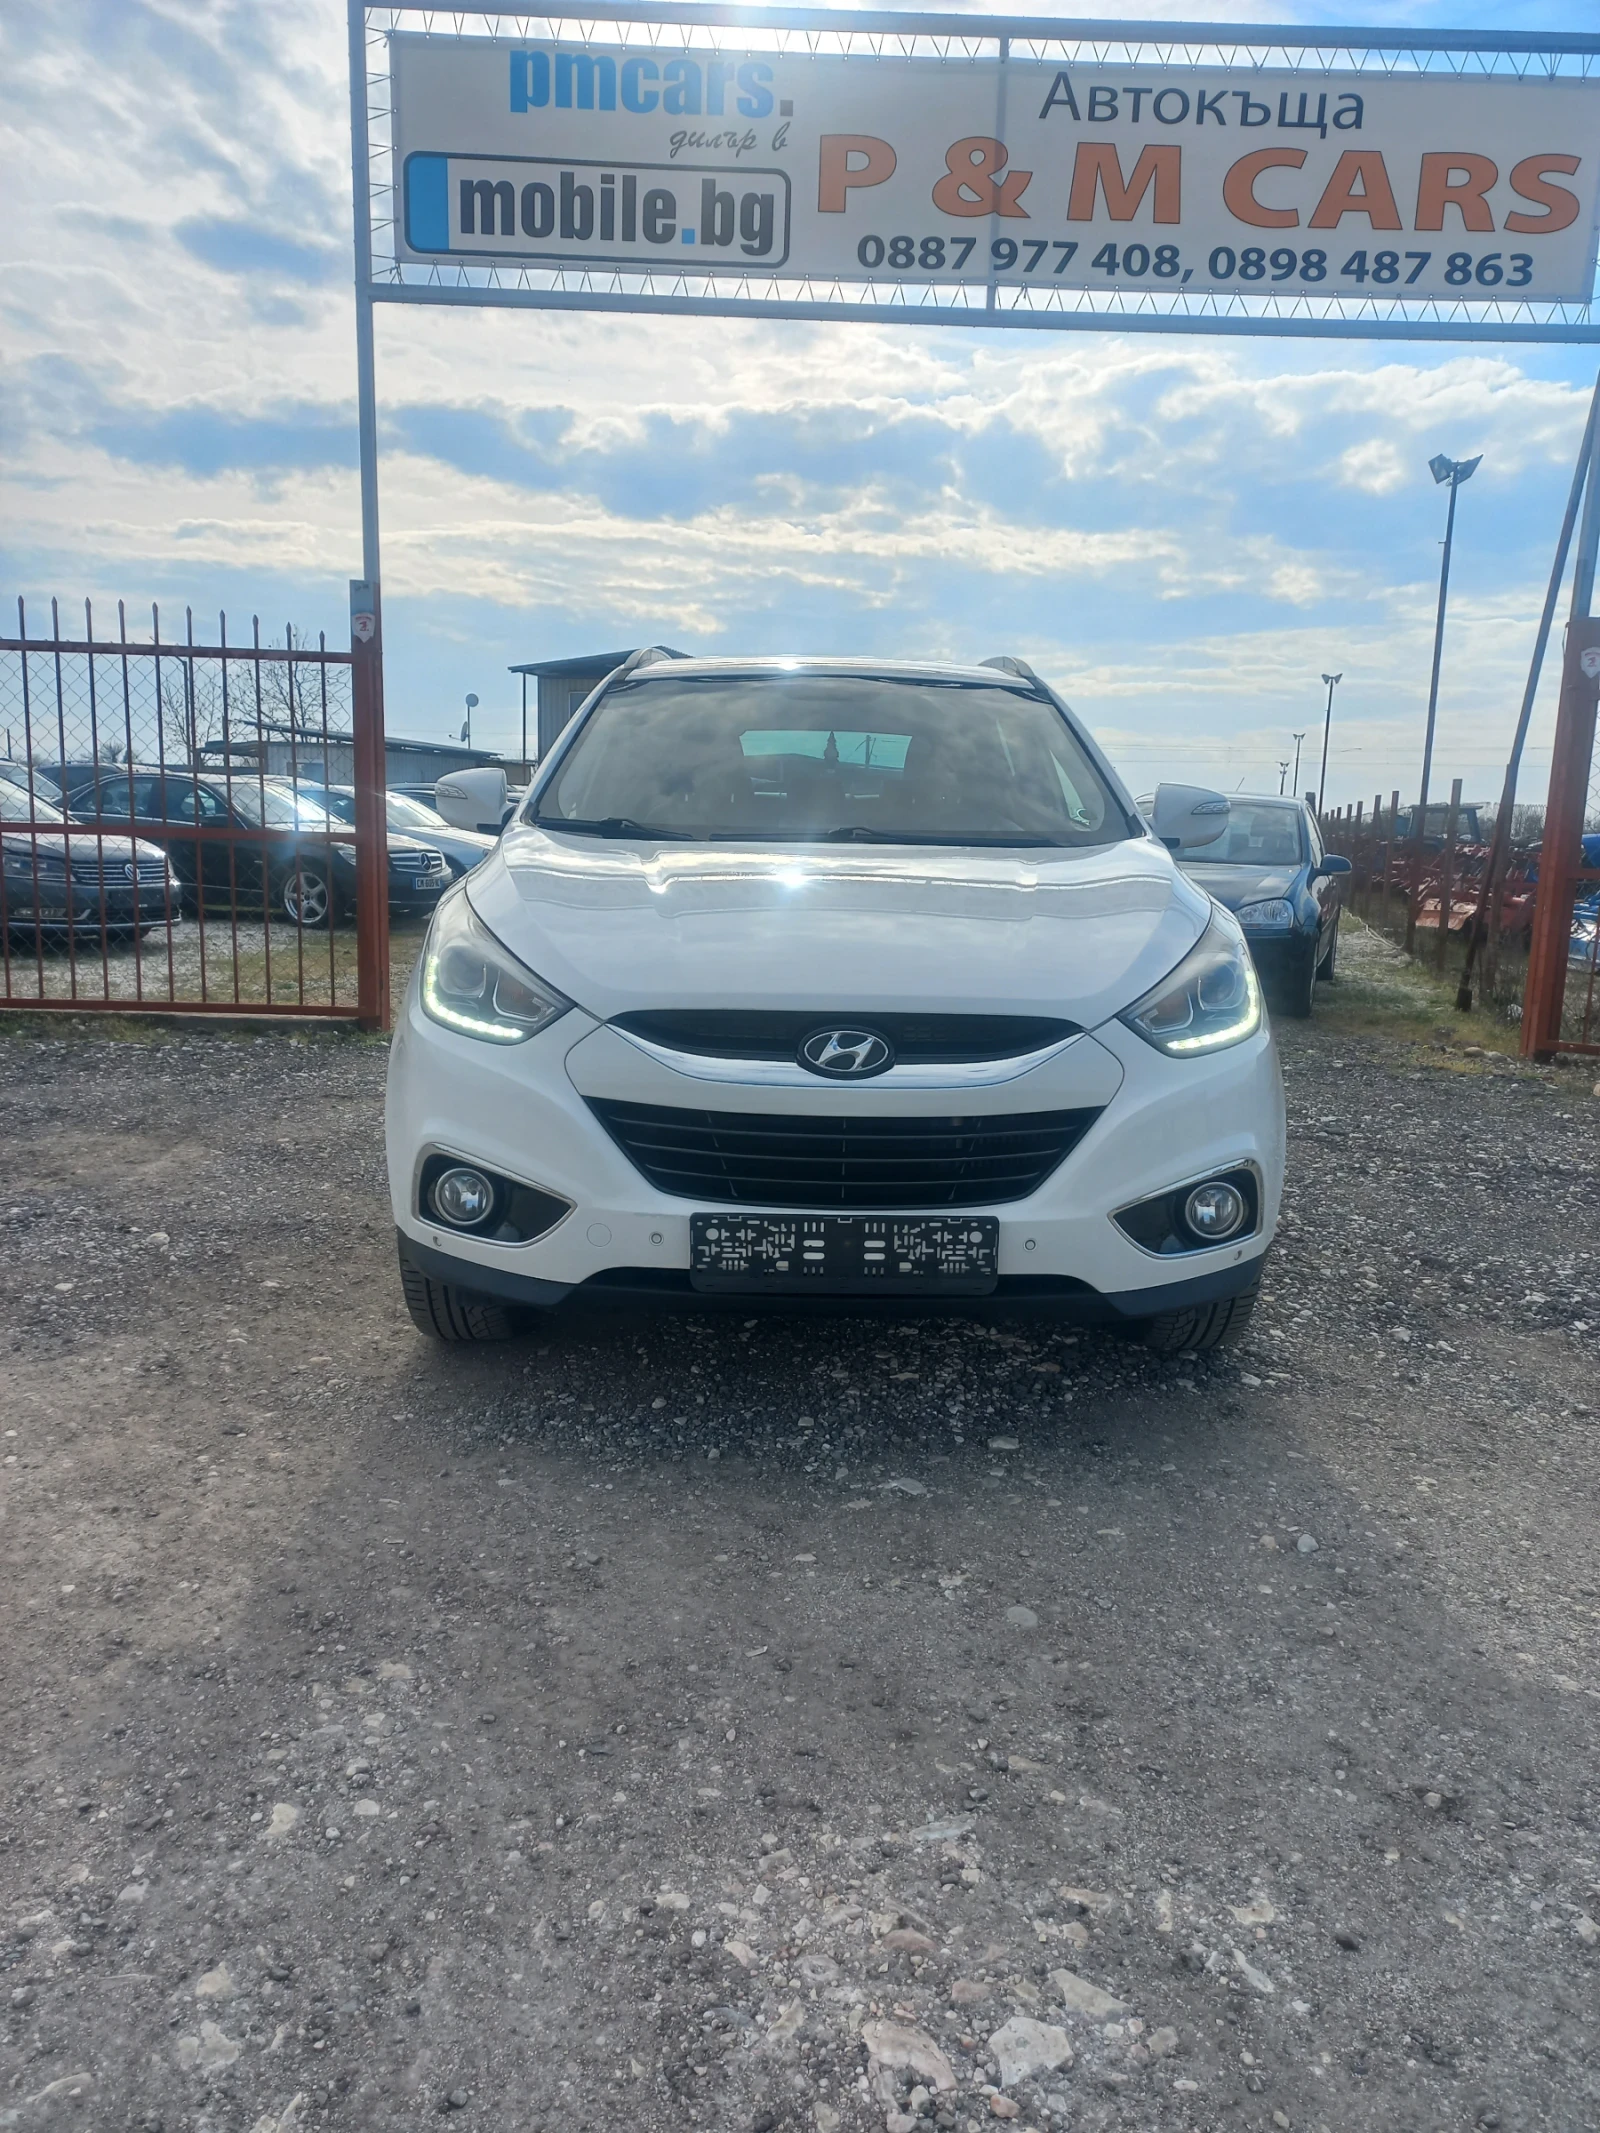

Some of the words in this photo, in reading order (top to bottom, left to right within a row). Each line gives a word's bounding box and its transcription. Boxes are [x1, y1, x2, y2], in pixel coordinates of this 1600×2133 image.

[1038, 70, 1365, 140] Автокъща
[669, 127, 758, 159] дилър
[459, 171, 775, 257] mobile.bg
[817, 133, 898, 214] P
[931, 136, 1034, 219] &
[1066, 141, 1182, 225] M
[1222, 146, 1583, 235] CARS
[857, 234, 977, 271] 0887
[990, 236, 1080, 274] 977
[1091, 242, 1195, 285] 408,
[1208, 245, 1328, 283] 0898
[1340, 250, 1432, 285] 487
[1443, 251, 1534, 287] 863
